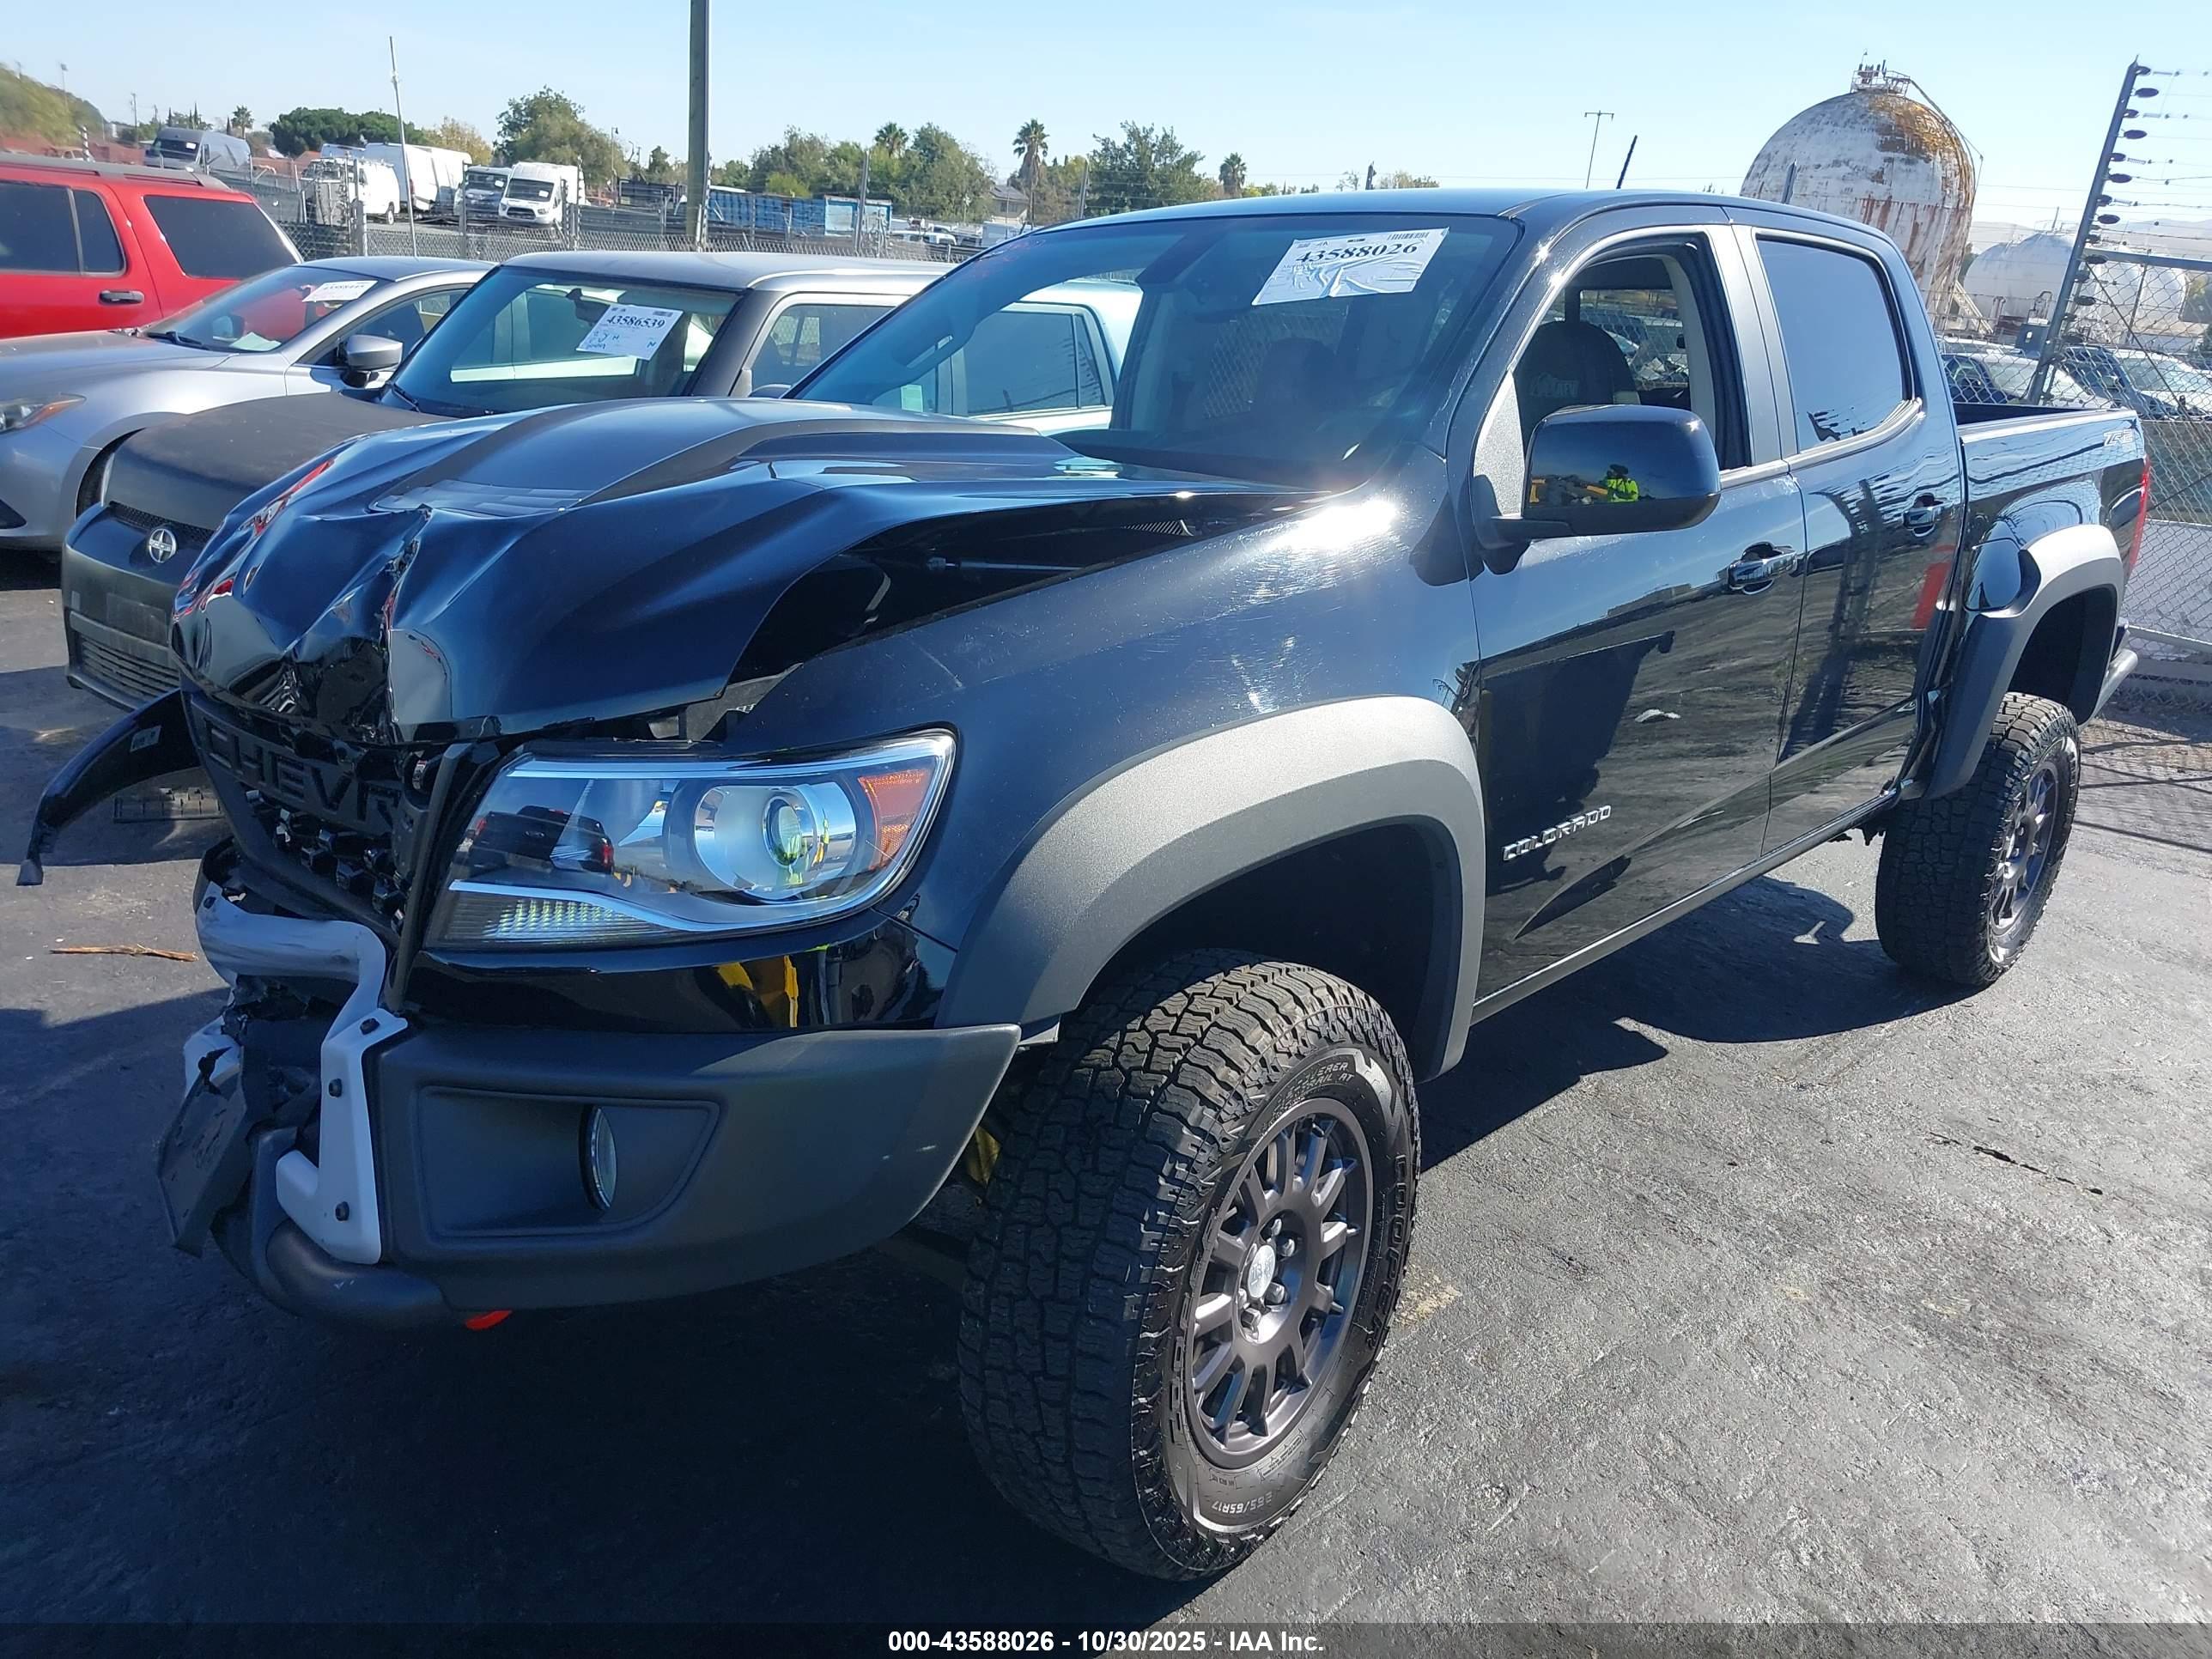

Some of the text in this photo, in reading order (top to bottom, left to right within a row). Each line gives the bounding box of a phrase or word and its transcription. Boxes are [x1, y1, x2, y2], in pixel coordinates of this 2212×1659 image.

[1296, 242, 1418, 262] 43588026
[606, 314, 665, 329] 43586539
[204, 717, 402, 830] CHEVR
[1503, 805, 1612, 861] COLORADO
[1211, 1492, 1273, 1515] 265/65R17
